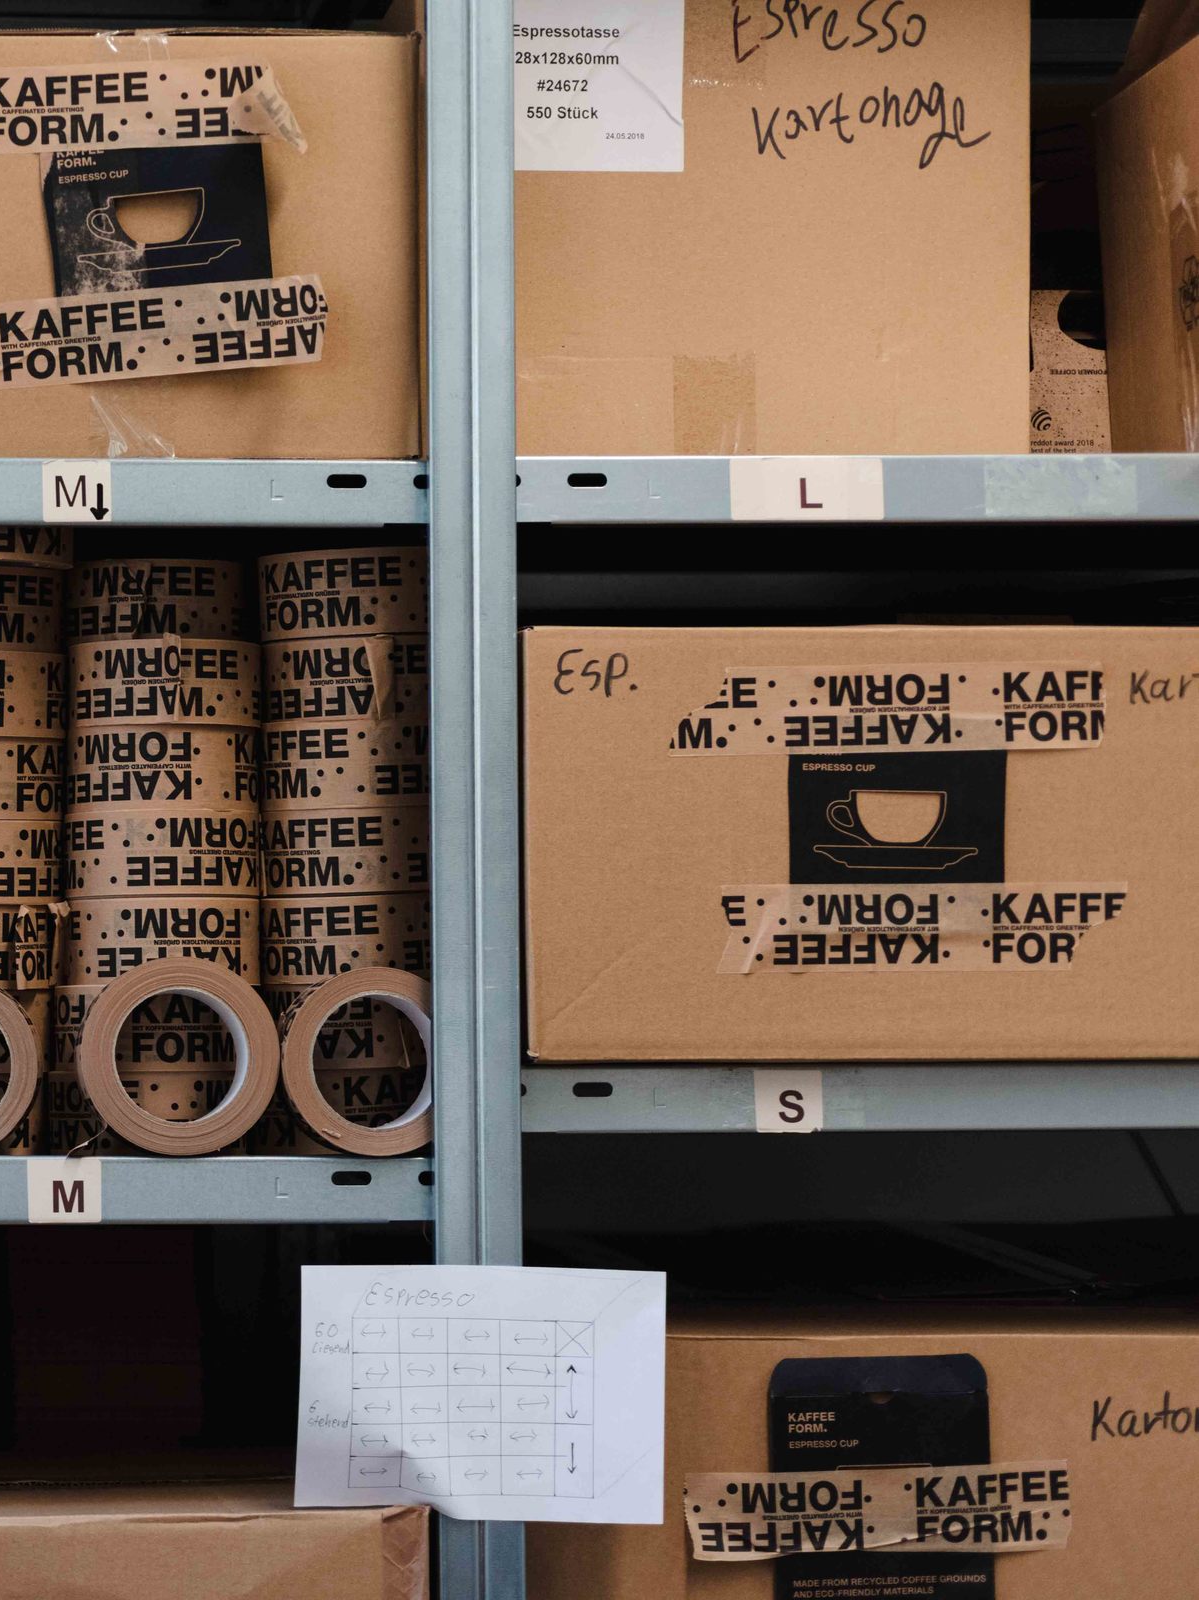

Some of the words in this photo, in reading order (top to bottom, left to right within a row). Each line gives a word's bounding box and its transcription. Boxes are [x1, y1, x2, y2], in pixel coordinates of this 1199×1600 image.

[513, 24, 620, 40] Espressotasse
[515, 52, 619, 64] 28x128x60mm
[537, 80, 588, 91] #24672
[527, 107, 551, 118] 550
[558, 106, 598, 119] Stück
[753, 81, 991, 168] Kartonage
[57, 157, 97, 169] FORM.
[59, 173, 107, 184] ESPRESSO
[109, 170, 129, 179] CUP
[18, 340, 63, 349] CAFFEINATED
[64, 336, 101, 344] GREETINGS
[193, 323, 324, 364] AFFEE
[55, 475, 87, 508] M
[801, 478, 823, 509] L
[265, 556, 402, 594] KAFFEE
[555, 649, 637, 697] Esp.
[784, 713, 951, 747] KAFFEE
[803, 763, 852, 771] ESPRESSO
[127, 856, 257, 887] KAFFEE
[773, 934, 939, 965] KAFFEE
[993, 932, 1084, 963] FOR
[779, 1089, 805, 1124] S
[52, 1180, 87, 1214] M
[365, 1281, 475, 1307] Espresso
[788, 1412, 835, 1421] KAFFEE
[788, 1424, 827, 1433] FORM.
[1091, 1390, 1199, 1441] Karto
[789, 1440, 837, 1448] ESPRESSO
[916, 1470, 1069, 1508] KAFFEE
[698, 1518, 864, 1552] KAFFEE
[852, 1578, 899, 1586] RECYCLED
[902, 1576, 937, 1584] COFFEE
[940, 1575, 986, 1583] GROUNDS
[884, 1586, 934, 1595] MATERIALS
